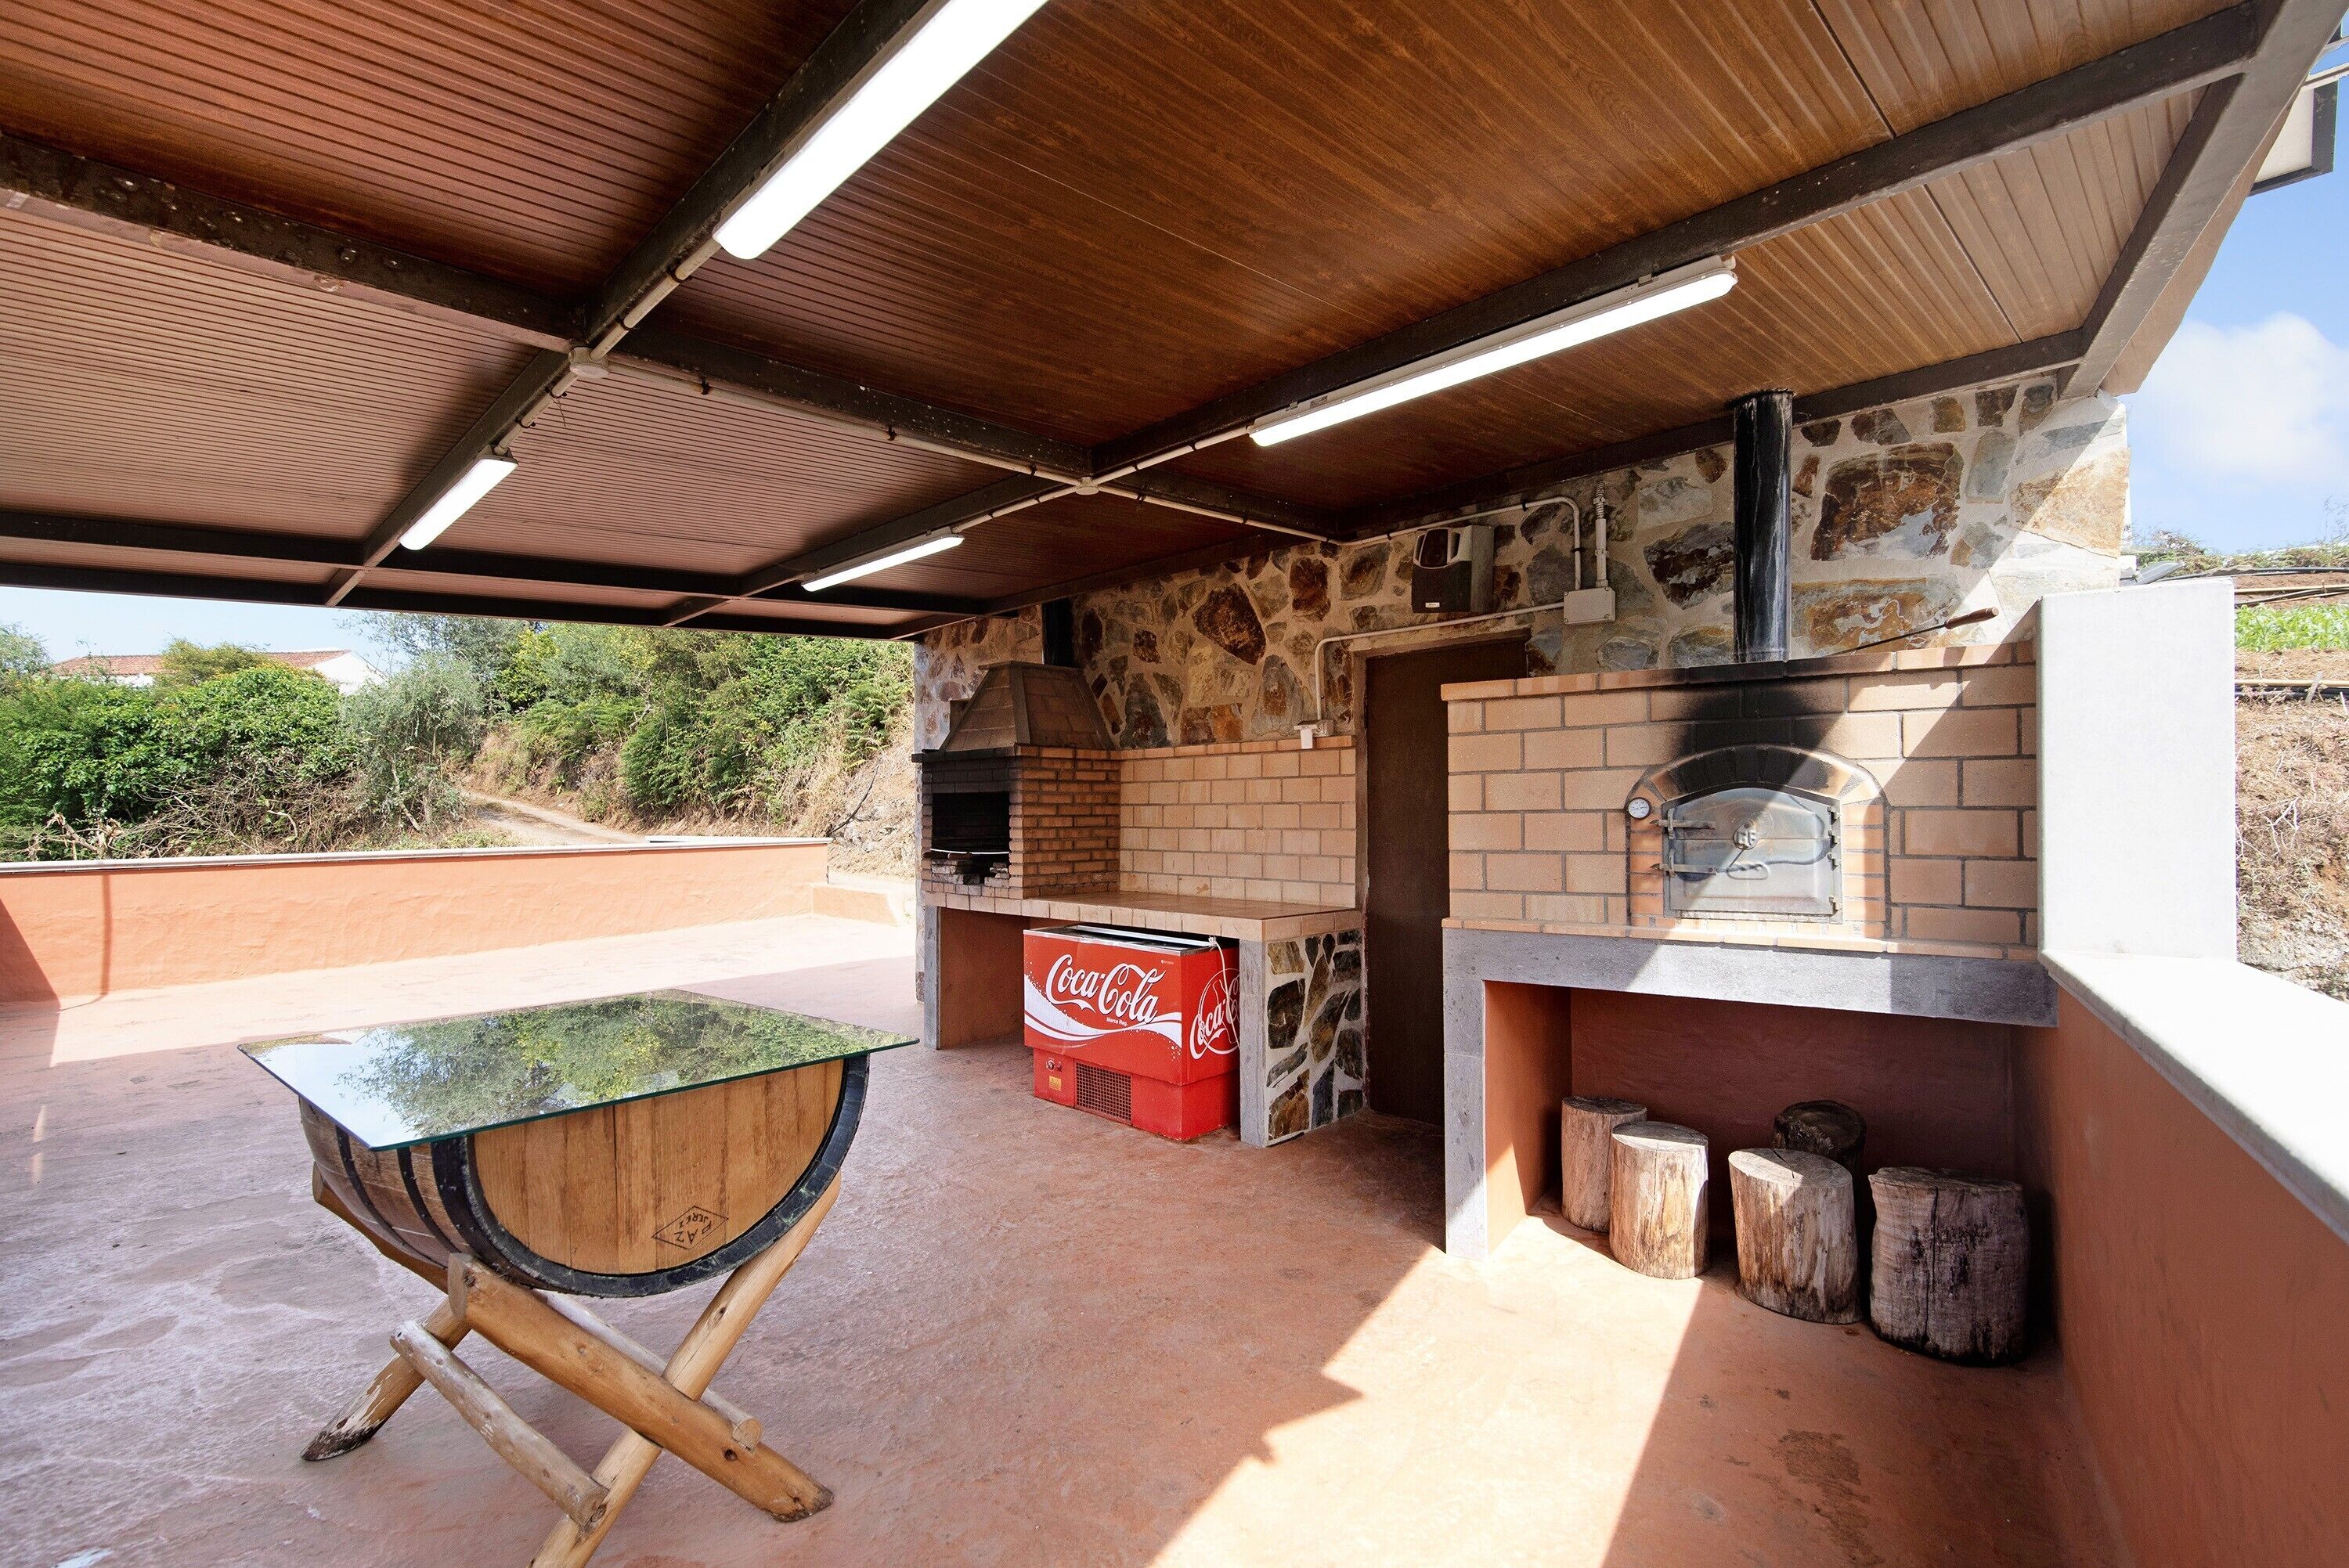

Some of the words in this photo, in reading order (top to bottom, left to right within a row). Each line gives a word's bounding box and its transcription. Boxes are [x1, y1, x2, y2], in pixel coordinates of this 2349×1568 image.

[1046, 953, 1167, 1023] Coca-Cola
[674, 1220, 712, 1244] PAZ
[679, 1212, 709, 1229] JEREZ
